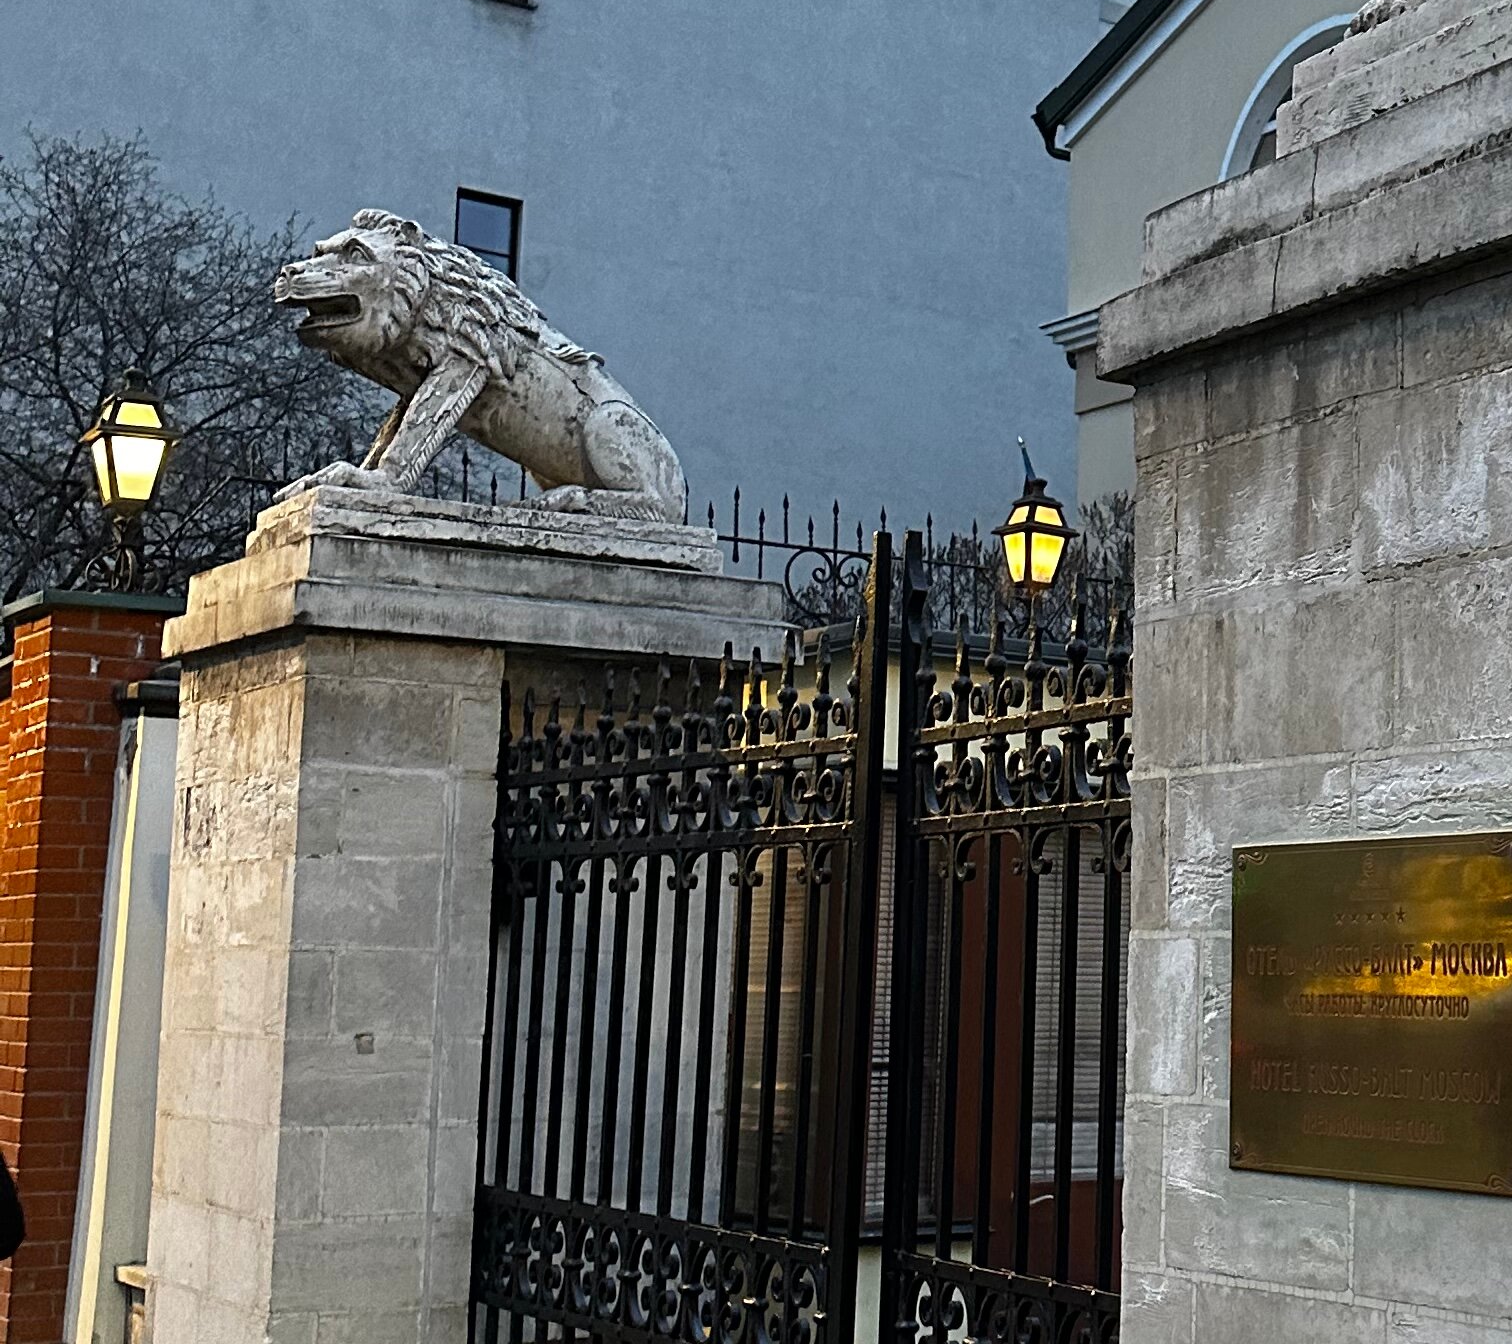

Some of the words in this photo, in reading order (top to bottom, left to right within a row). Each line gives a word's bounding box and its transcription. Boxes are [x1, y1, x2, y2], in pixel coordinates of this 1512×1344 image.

[1430, 942, 1508, 977] МОСКВА
[1370, 994, 1470, 1019] КРУГЛОСУТОЧНО
[1250, 1060, 1301, 1093] HOTEL
[1308, 1064, 1413, 1099] RUSSO-BALT
[1418, 1069, 1502, 1105] MOSCOW
